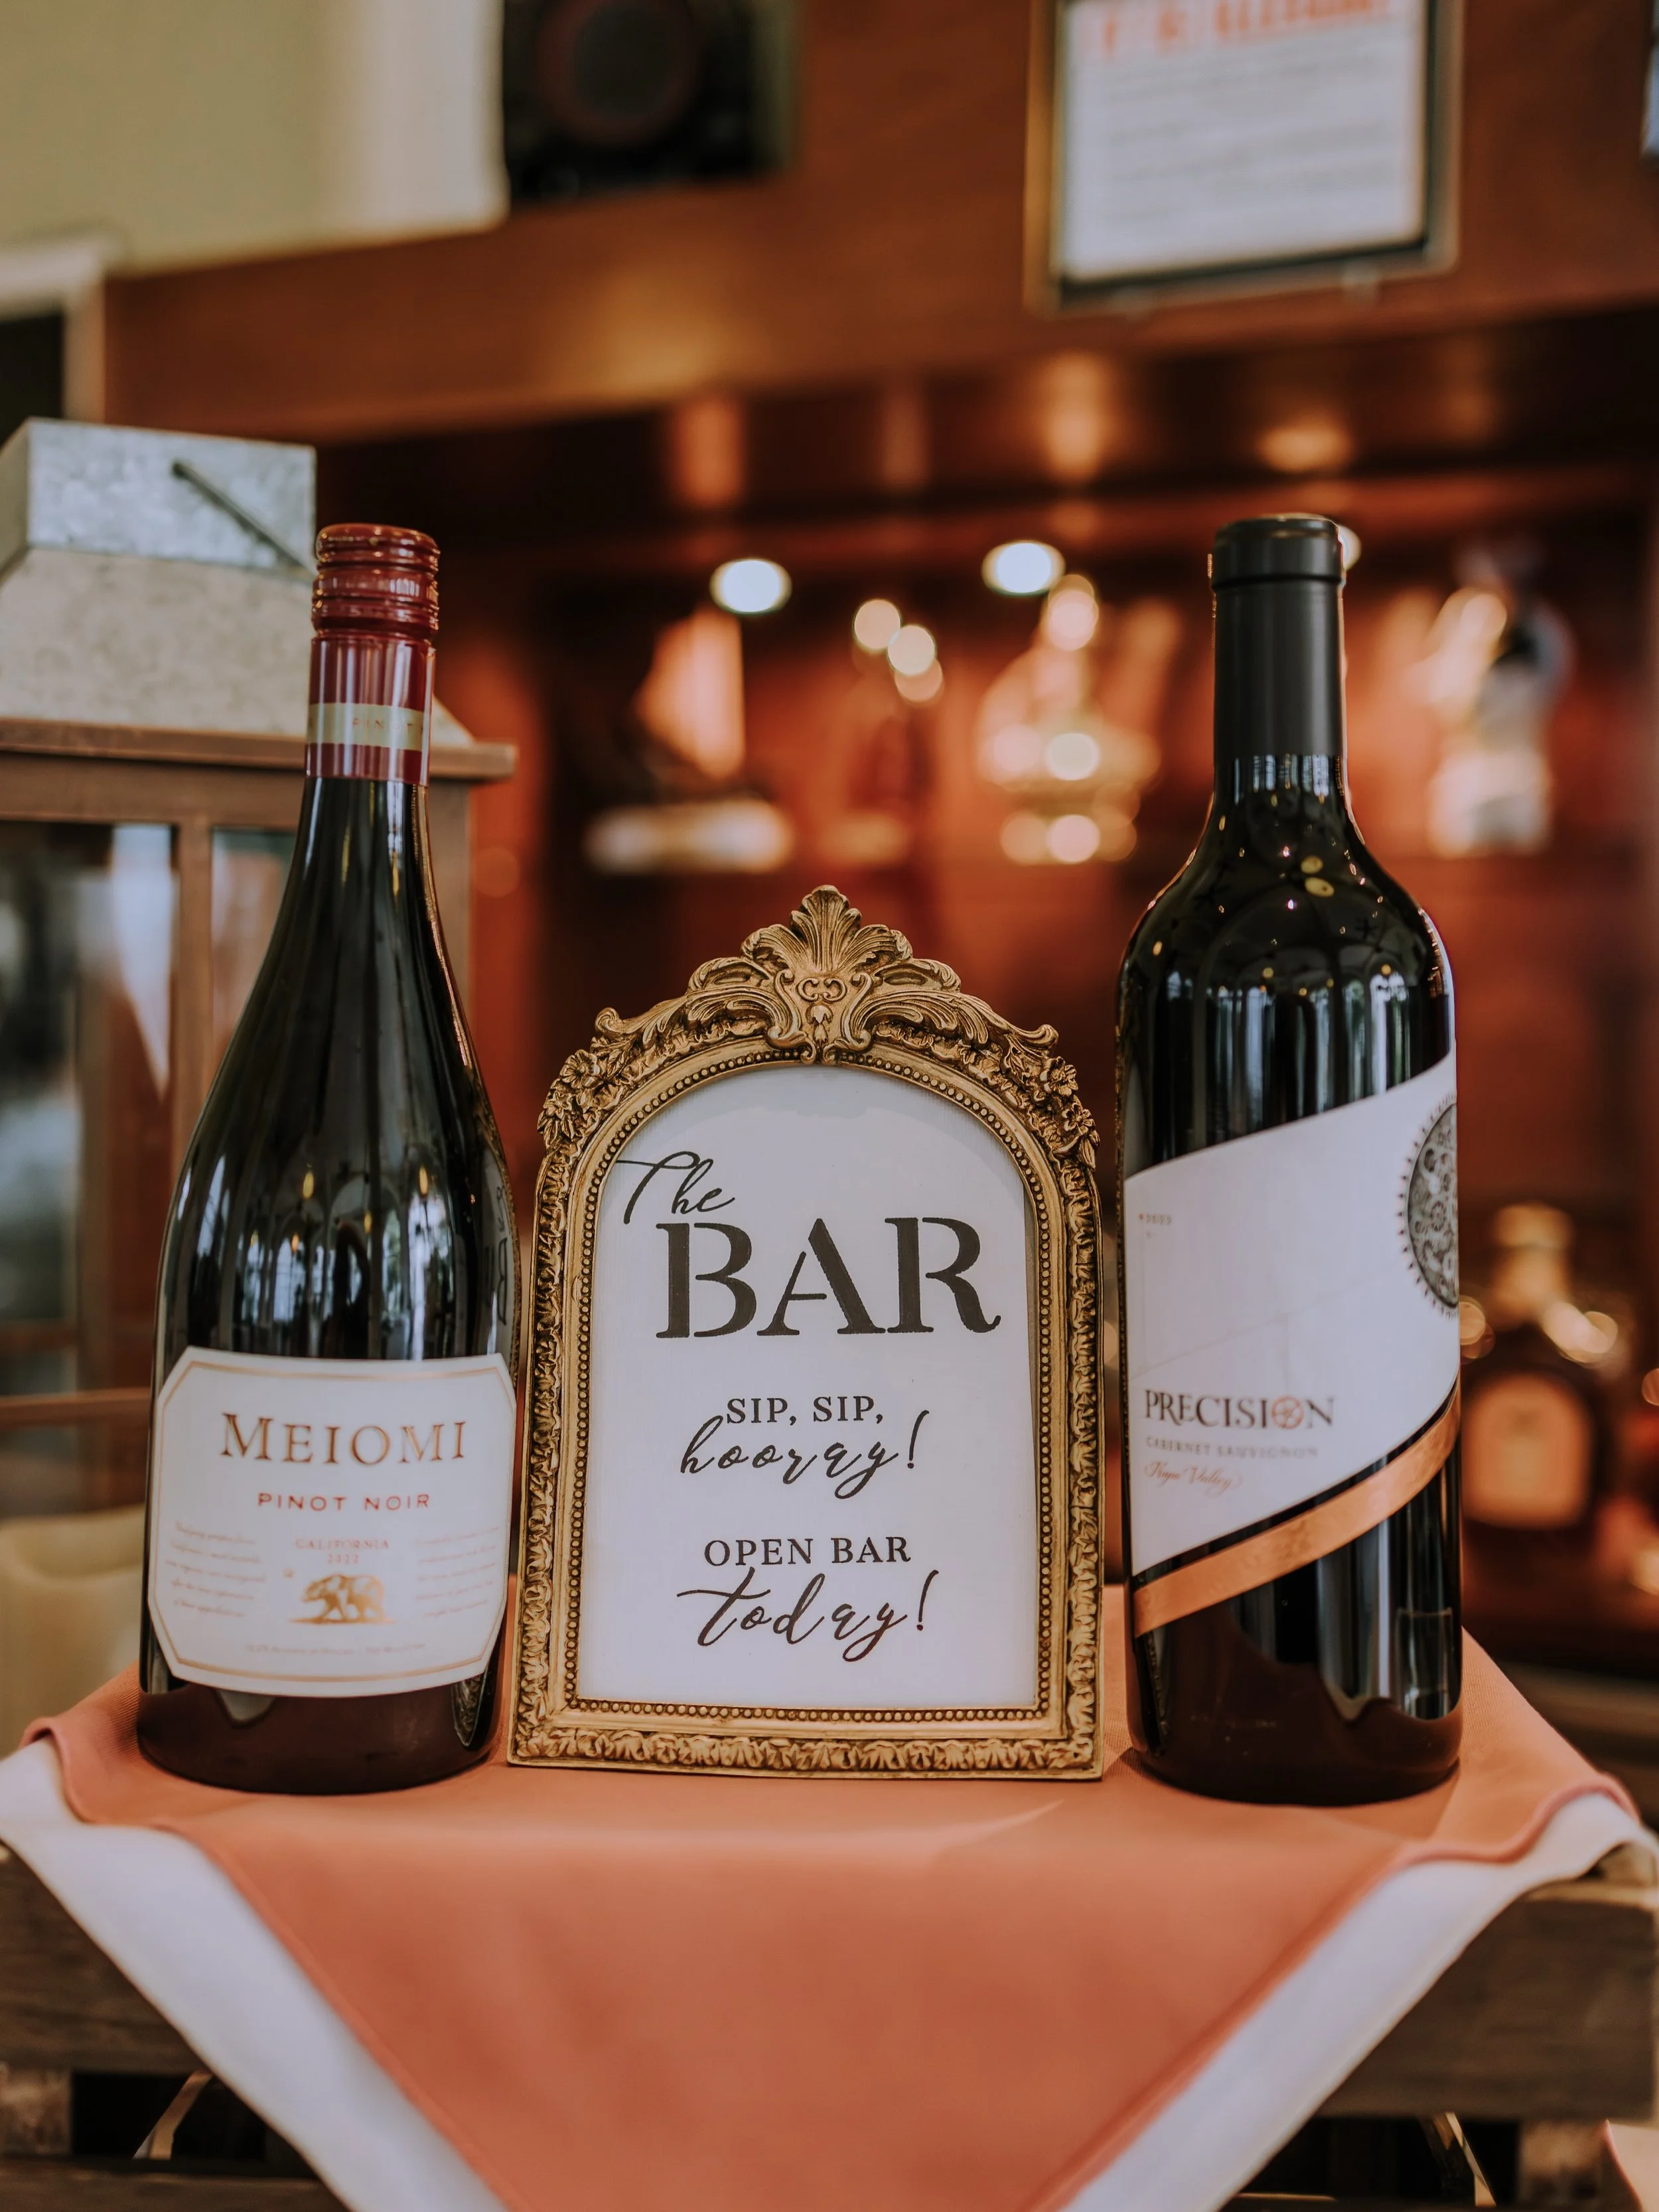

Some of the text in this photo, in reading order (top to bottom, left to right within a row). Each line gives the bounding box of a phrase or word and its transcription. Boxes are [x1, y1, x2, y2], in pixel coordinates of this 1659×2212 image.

[616, 1151, 736, 1225] The
[655, 1217, 1001, 1339] BAR
[726, 1395, 883, 1426] SIP, SIP,
[1145, 1390, 1335, 1430] PRECISION
[220, 1413, 467, 1465] MEIOMI
[680, 1409, 930, 1500] hooray!
[1146, 1436, 1319, 1459] CABERNET SAUVIGNON
[1144, 1461, 1244, 1499] Napa Valley
[257, 1493, 430, 1511] PINOT NOIR
[295, 1538, 390, 1550] CALIFORNIA
[704, 1536, 912, 1567] OPEN BAR
[676, 1566, 940, 1662] today!
